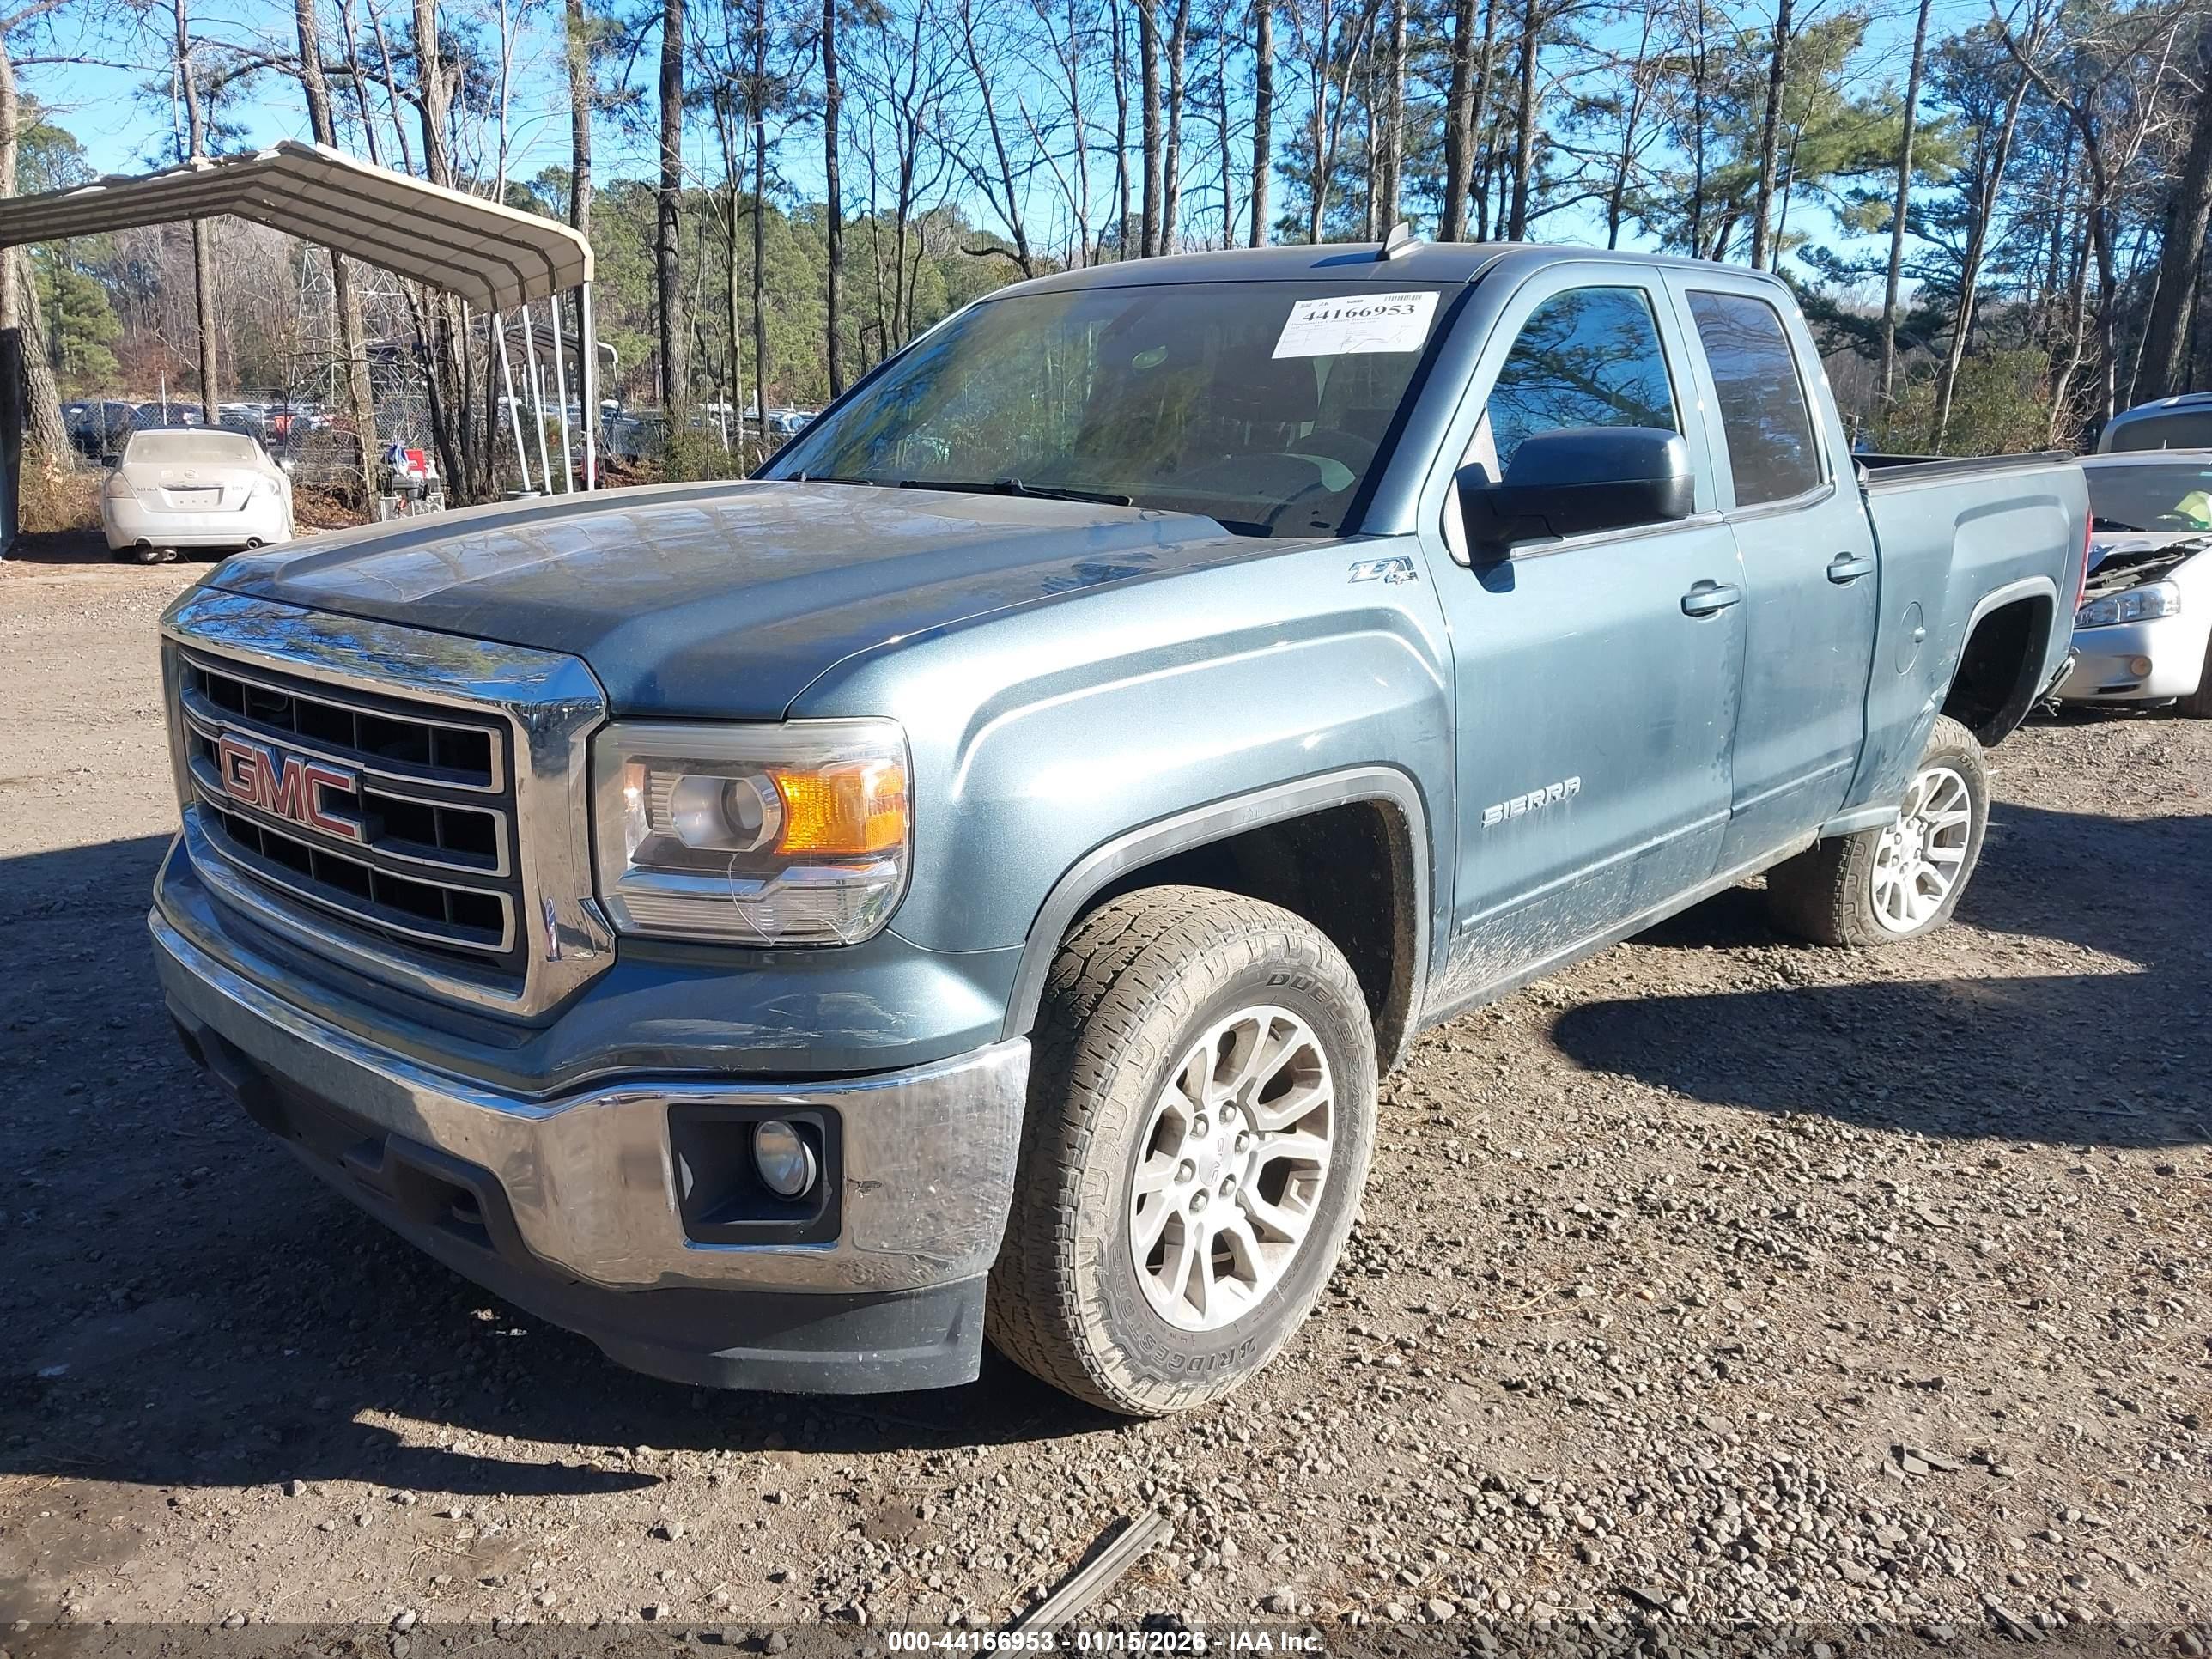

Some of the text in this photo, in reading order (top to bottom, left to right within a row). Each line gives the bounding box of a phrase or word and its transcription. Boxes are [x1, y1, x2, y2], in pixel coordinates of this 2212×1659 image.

[1303, 304, 1415, 322] 44166953
[219, 732, 362, 842] GMC
[1481, 776, 1581, 829] SIERRA
[1266, 972, 1362, 1075] DUELER
[1113, 1247, 1258, 1374] BRIDGESTONE
